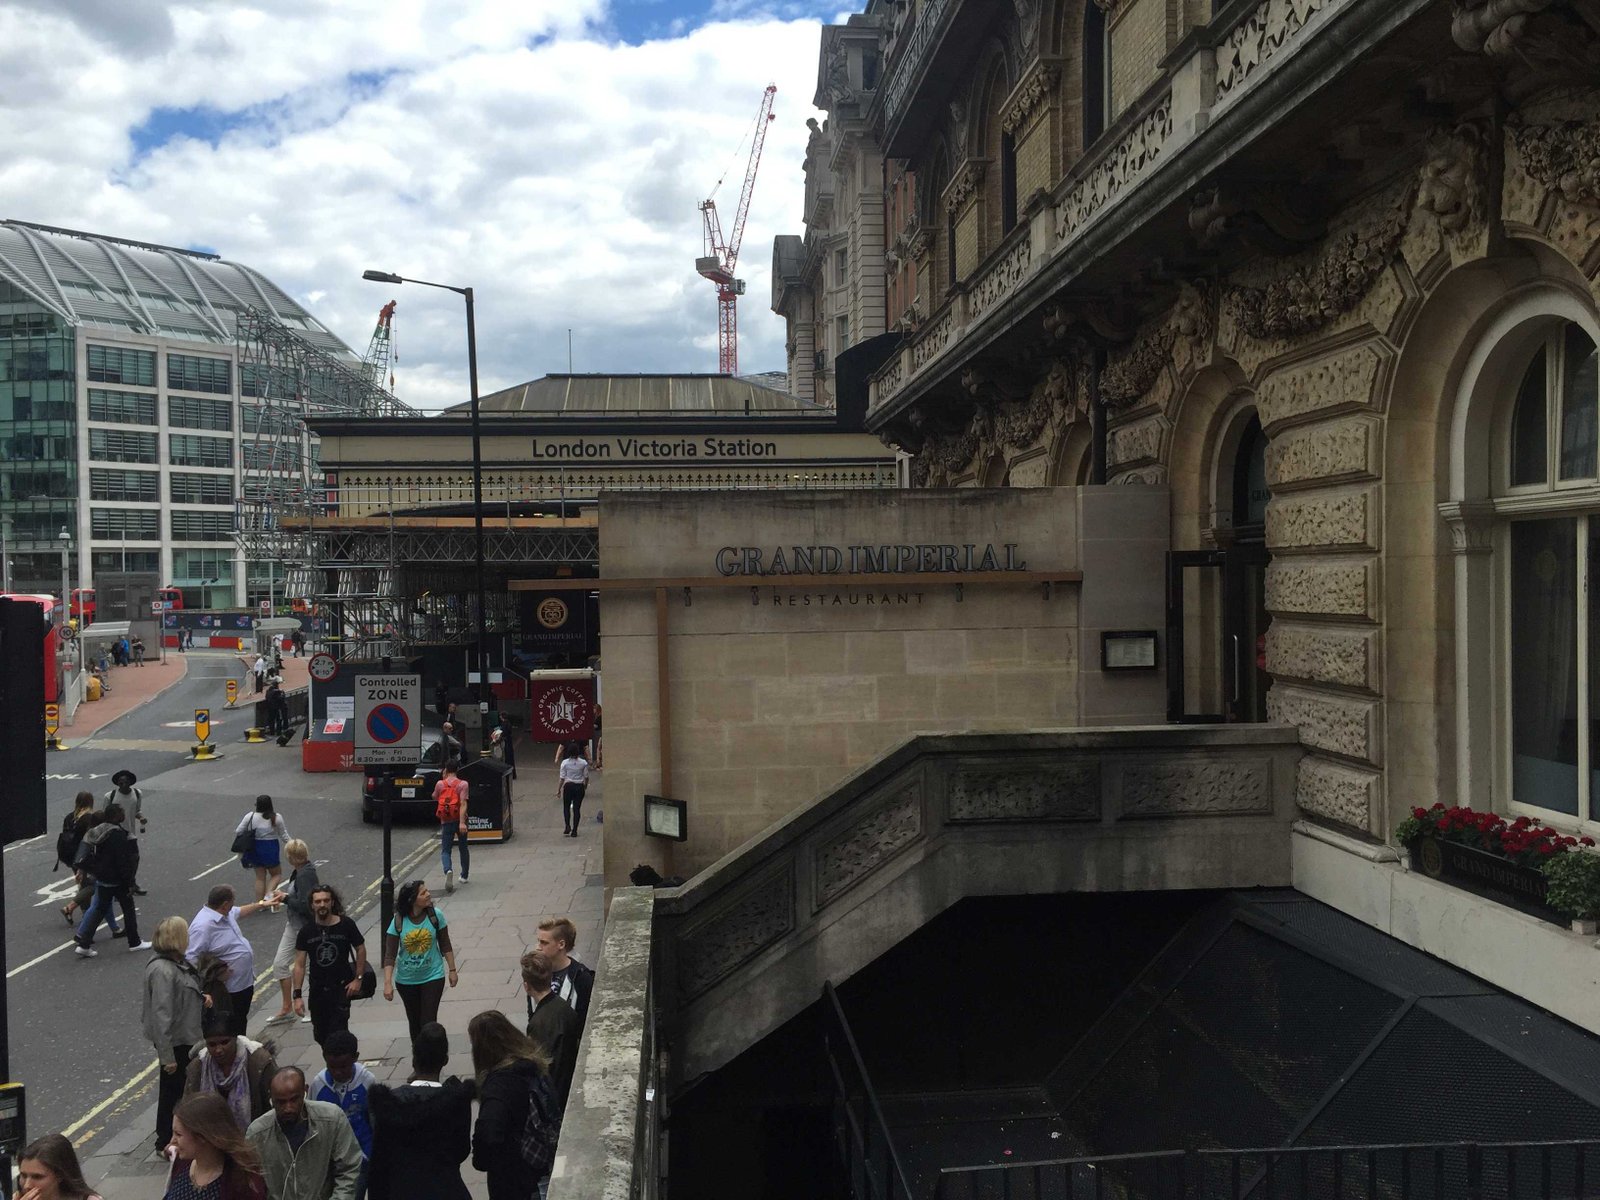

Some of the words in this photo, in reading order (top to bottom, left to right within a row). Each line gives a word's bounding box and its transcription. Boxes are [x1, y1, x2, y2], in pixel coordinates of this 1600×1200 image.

[532, 439, 611, 458] London
[617, 438, 698, 457] Victoria
[704, 438, 777, 457] Station
[715, 546, 843, 576] GRAND
[848, 543, 1027, 574] IMPERIAL
[773, 592, 924, 607] RESTAURANT
[63, 629, 72, 637] 10
[360, 677, 417, 687] Controlled
[368, 689, 408, 700] ZONE
[538, 686, 563, 709] ORGANIC
[566, 686, 587, 708] COFFEE
[550, 701, 576, 720] PRET
[541, 717, 569, 734] NATURAL
[571, 716, 586, 731] FOOD
[468, 822, 493, 830] andard
